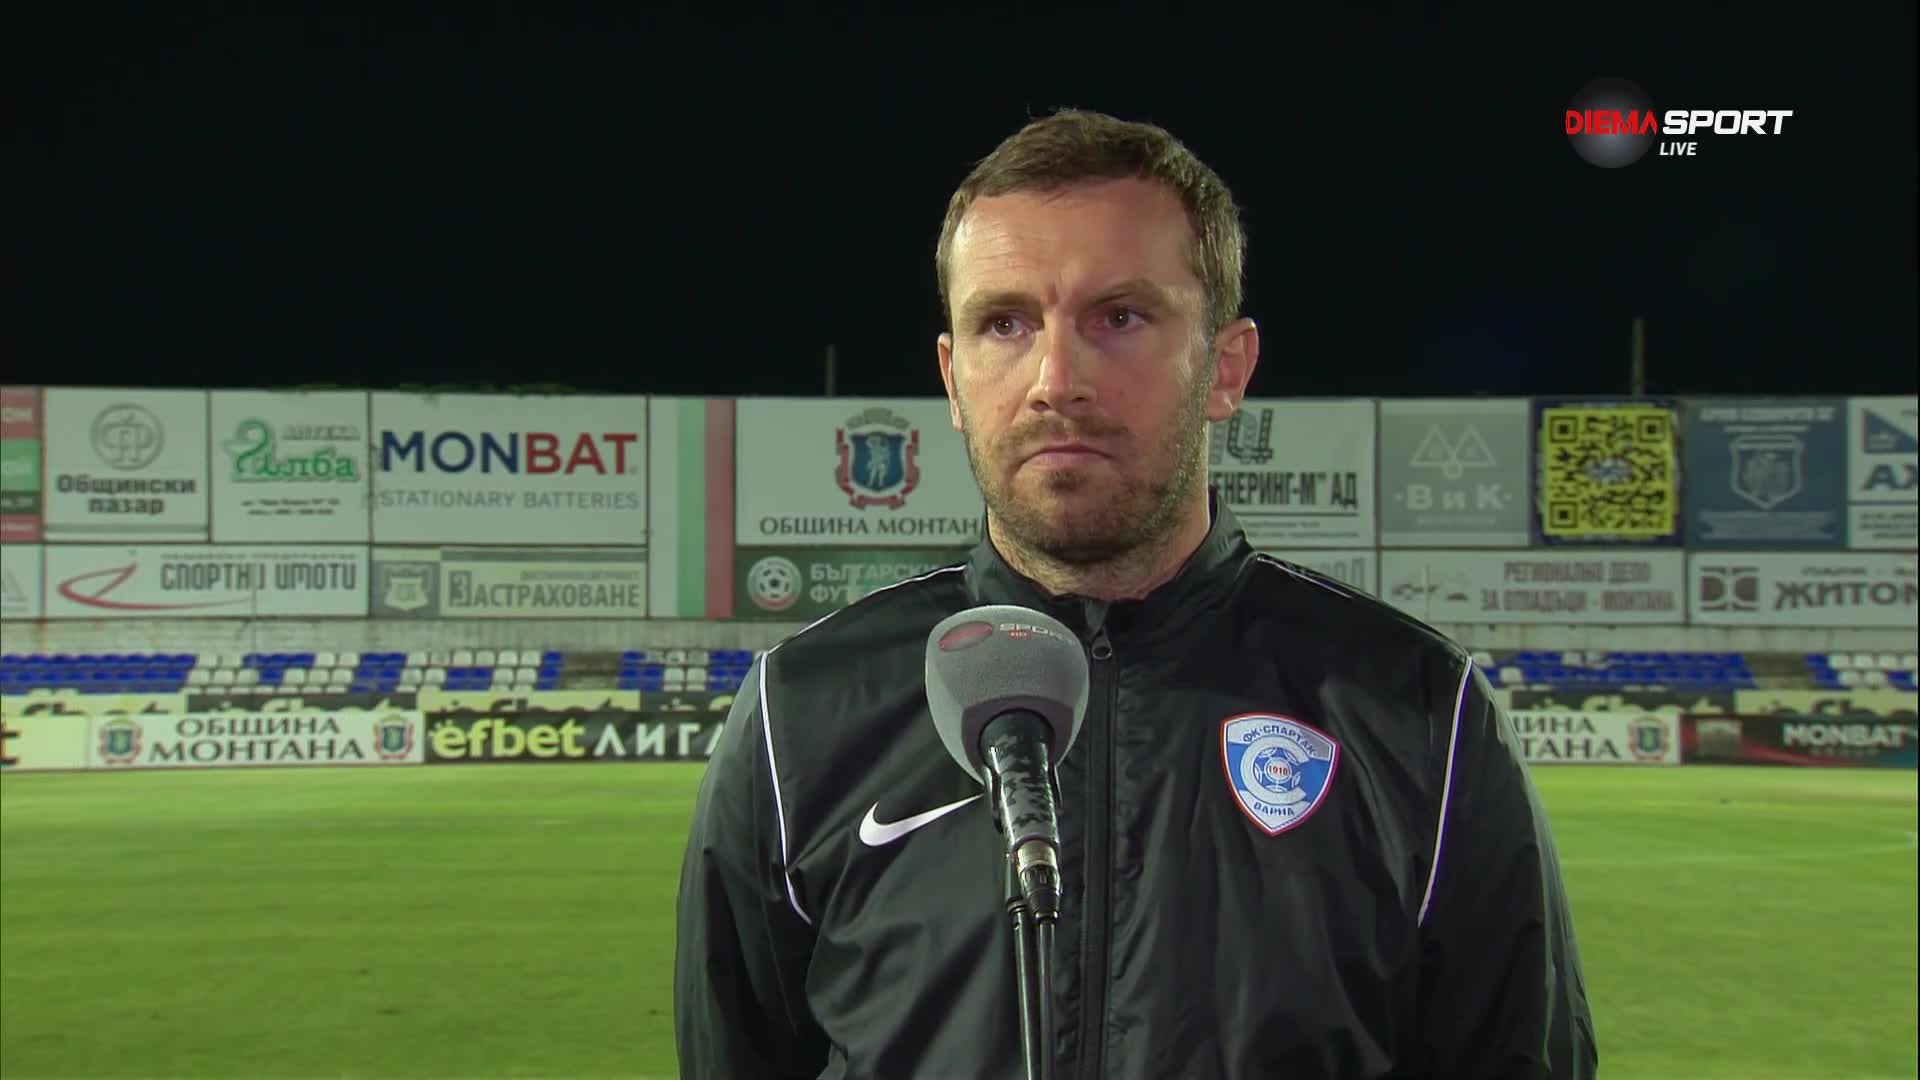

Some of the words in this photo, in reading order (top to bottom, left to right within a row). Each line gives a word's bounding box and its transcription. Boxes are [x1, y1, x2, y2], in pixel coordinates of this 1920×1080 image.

[381, 430, 638, 475] MONBAT
[56, 475, 196, 496] Общински
[1209, 472, 1327, 505] ЕНЕРИНГ-М"
[1330, 472, 1358, 511] АД
[89, 498, 164, 514] пазар
[380, 490, 514, 508] STATIONARY
[523, 491, 640, 510] BATTERIES
[759, 517, 869, 536] ОБЩИНА
[877, 517, 978, 535] МОНТАН
[175, 717, 341, 737] ОБЩИНА
[1783, 724, 1905, 747] MONBAT
[431, 719, 586, 757] efbet
[149, 739, 365, 763] МОНТАНА
[1253, 801, 1295, 816] ВАРНА
